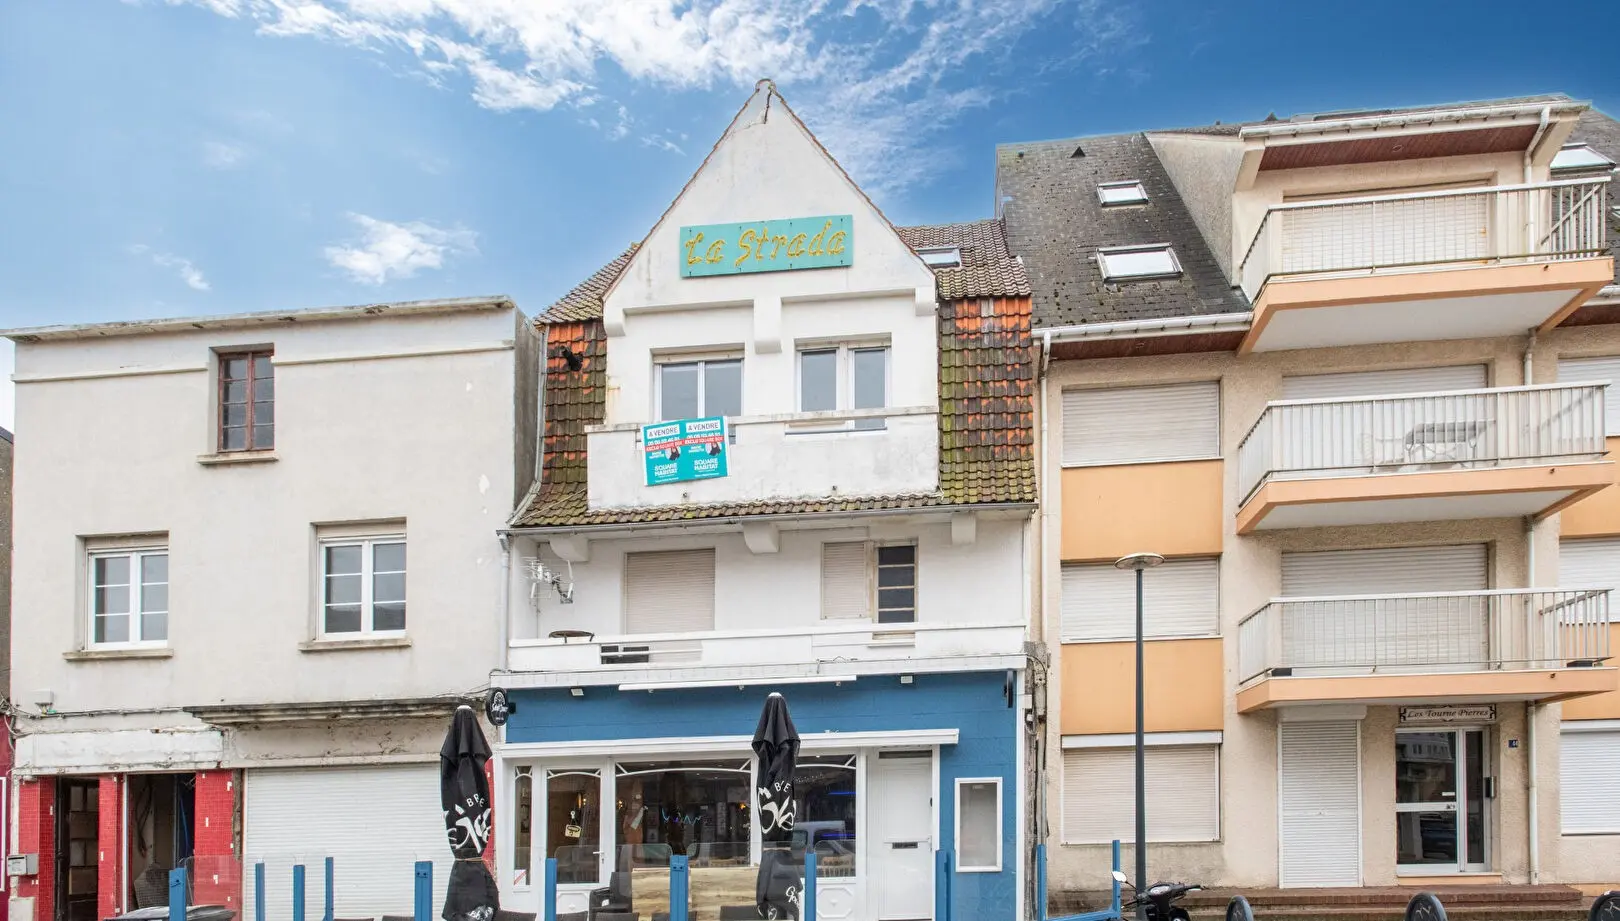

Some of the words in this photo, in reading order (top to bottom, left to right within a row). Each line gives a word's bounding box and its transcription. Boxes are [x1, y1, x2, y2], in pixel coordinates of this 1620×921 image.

[685, 231, 727, 266] La
[735, 219, 847, 267] Strada
[654, 426, 679, 436] VENDRE
[693, 422, 719, 430] VENDRE
[654, 462, 678, 471] SQUARE
[1407, 710, 1423, 718] Les
[1426, 709, 1456, 717] Tourne
[1459, 708, 1489, 717] Pierres
